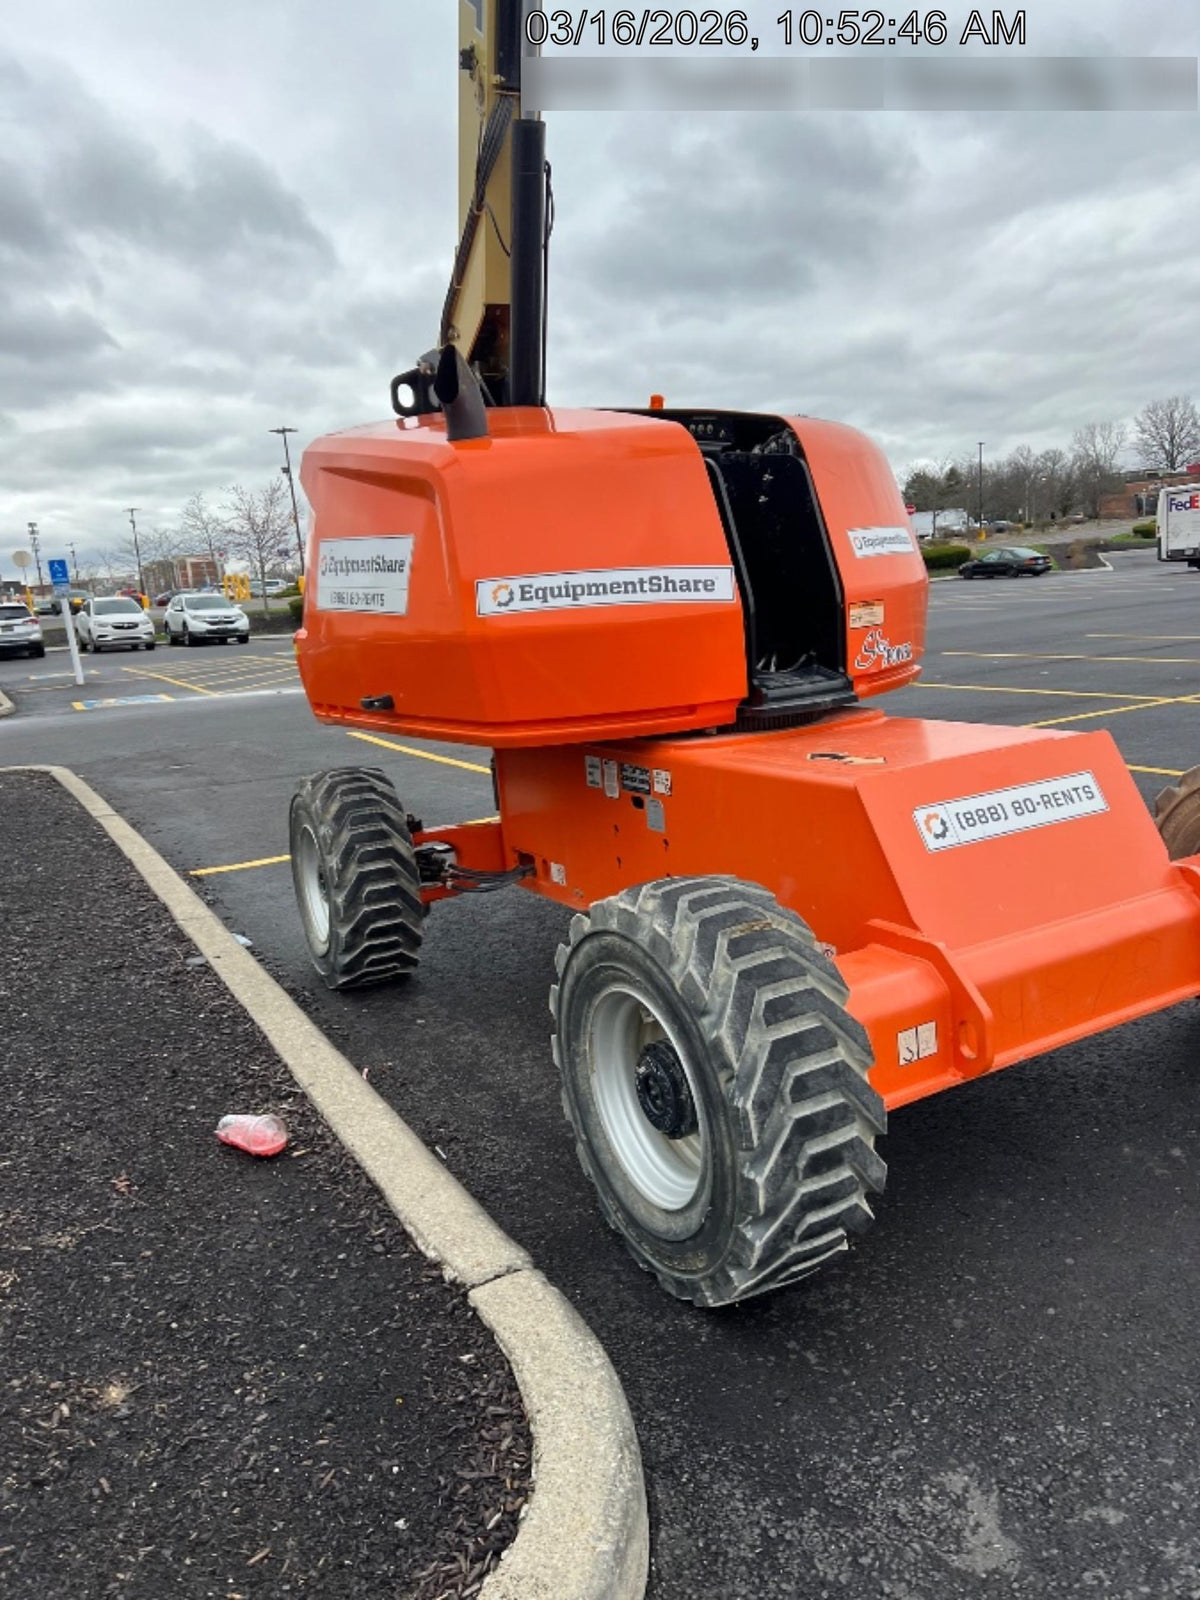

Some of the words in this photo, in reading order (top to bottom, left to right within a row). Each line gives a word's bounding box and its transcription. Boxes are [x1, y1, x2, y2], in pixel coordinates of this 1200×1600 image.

[518, 575, 715, 603] EquipmentShare
[955, 803, 1008, 831] (888)
[1011, 785, 1095, 817] 80-RENTS
